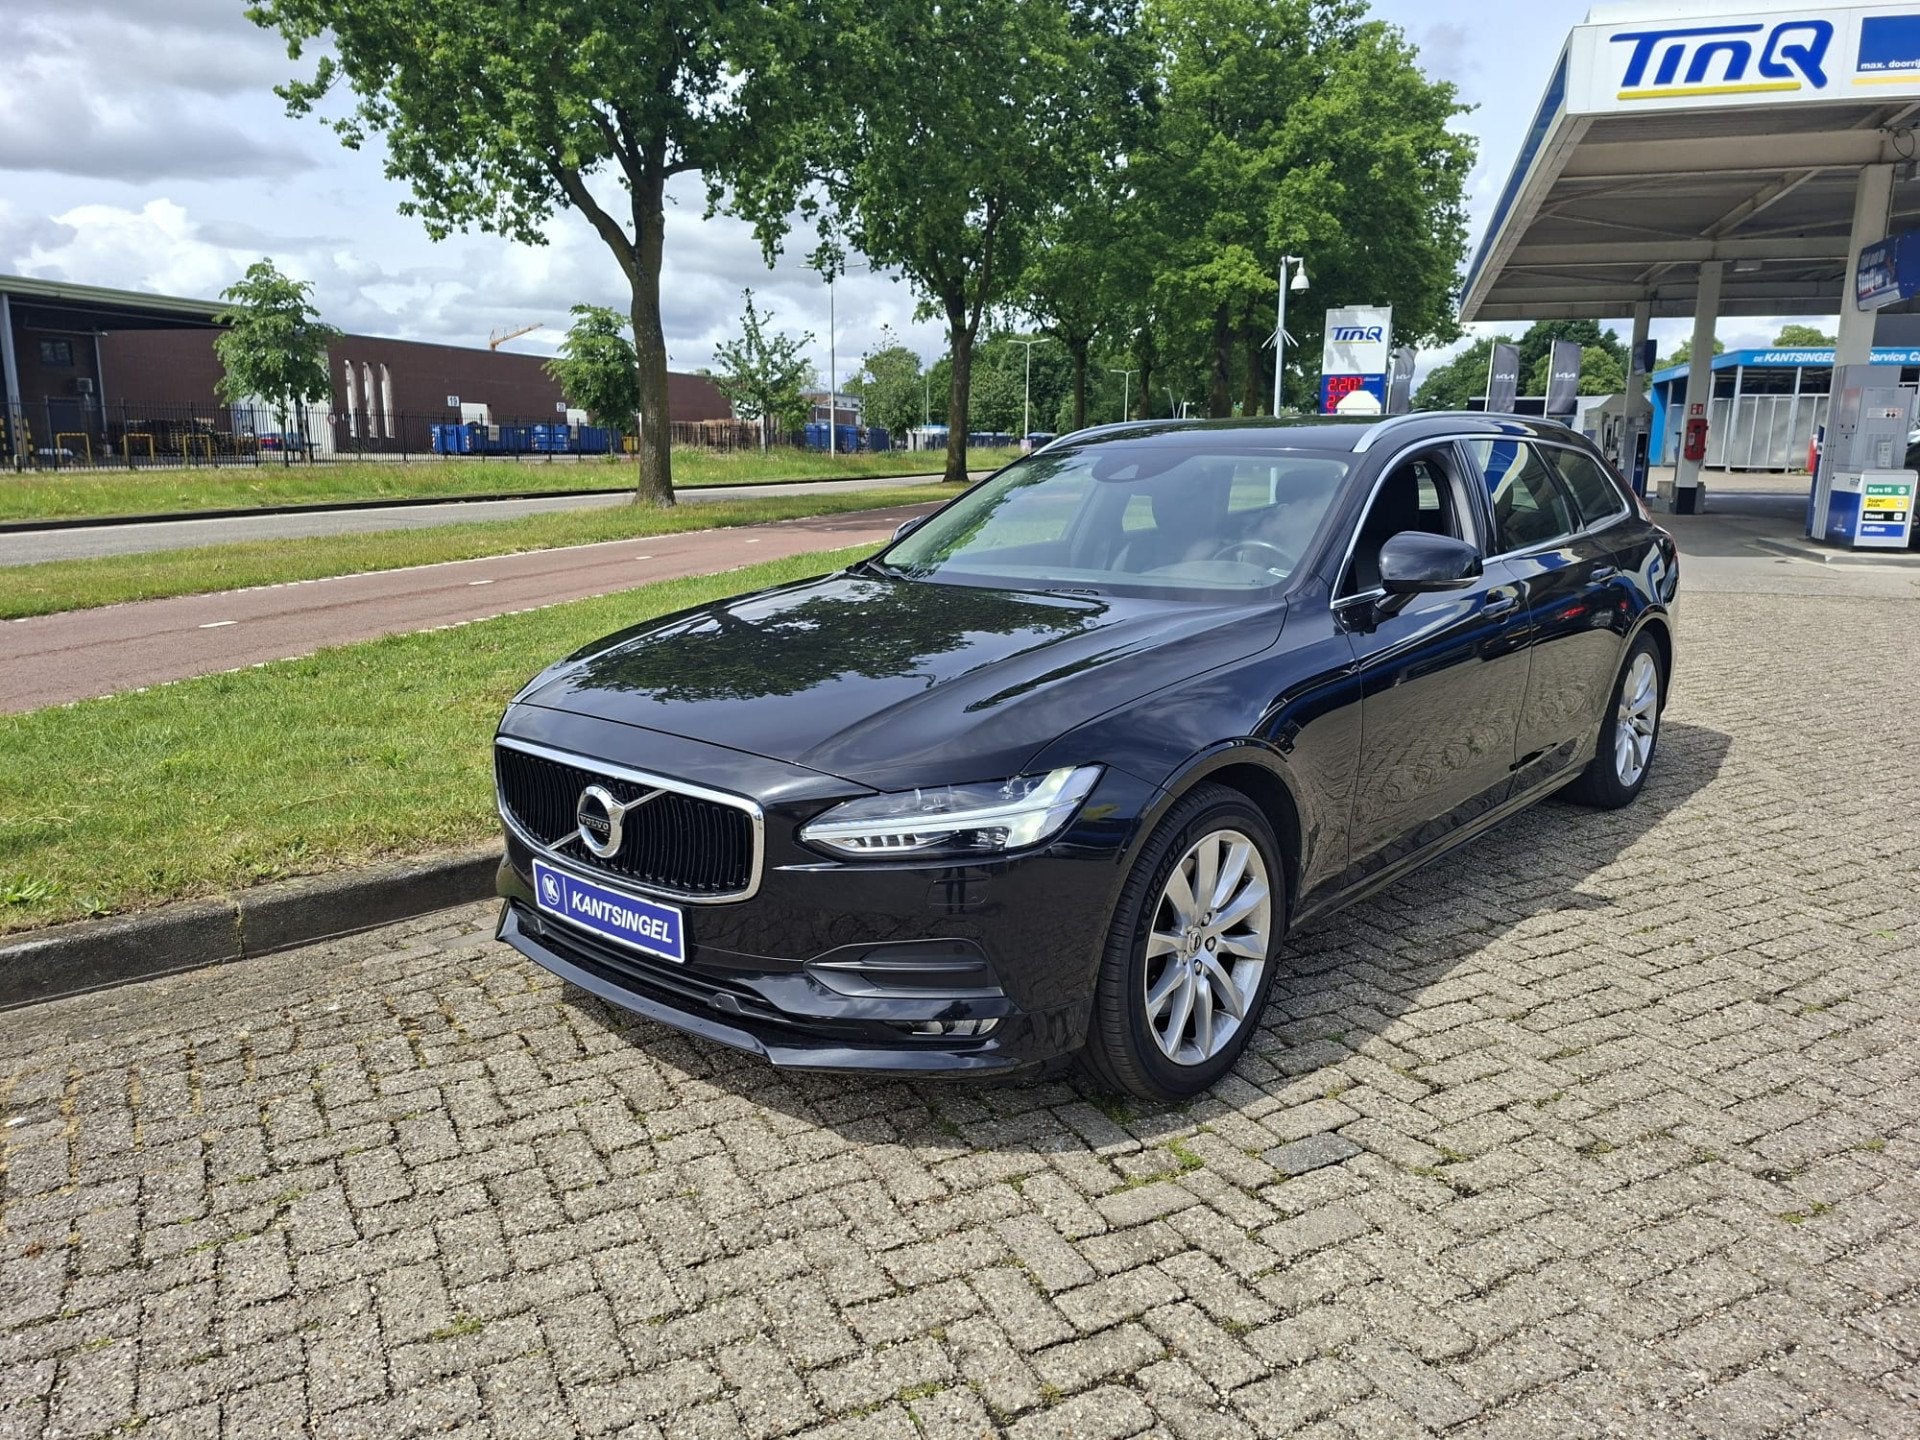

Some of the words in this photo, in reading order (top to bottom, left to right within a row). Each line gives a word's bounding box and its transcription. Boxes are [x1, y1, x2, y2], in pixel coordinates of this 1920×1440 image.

[1860, 62, 1886, 70] max.
[579, 815, 609, 830] VOLVO
[1144, 832, 1186, 914] MICHELIN
[571, 890, 673, 944] KANTSINGEL
